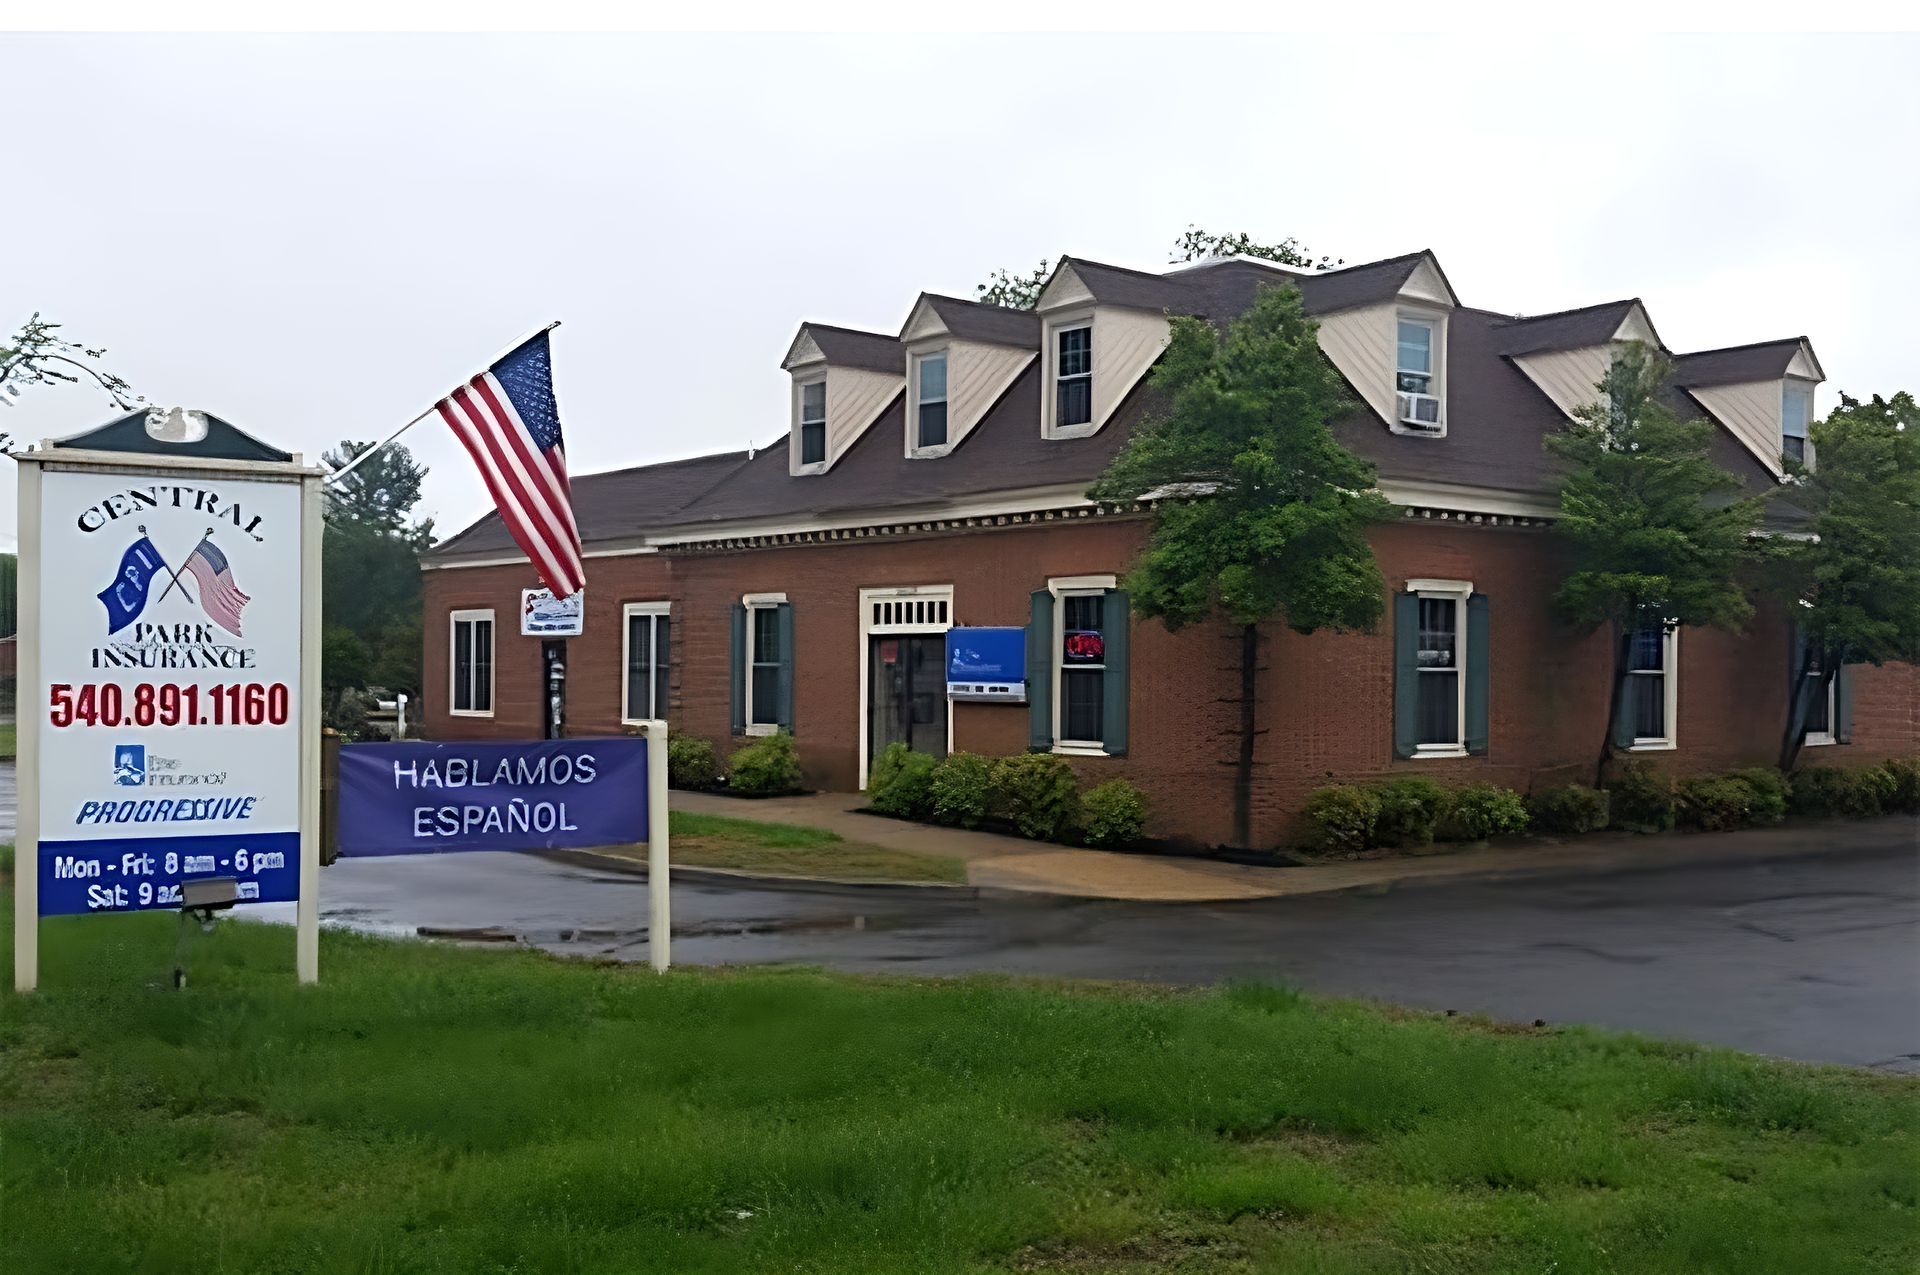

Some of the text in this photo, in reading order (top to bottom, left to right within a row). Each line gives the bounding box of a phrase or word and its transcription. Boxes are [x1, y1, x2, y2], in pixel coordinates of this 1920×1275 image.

[77, 486, 264, 542] CENTRAL
[135, 622, 213, 644] PARK
[92, 647, 257, 669] INSURANCE
[50, 683, 288, 727] 540.891.1160
[393, 754, 596, 789] HABLAMOS
[413, 797, 578, 837] ESPAÑOL
[55, 856, 100, 878] Mon
[165, 852, 178, 875] 8
[234, 848, 249, 872] 6
[138, 882, 153, 906] 9
